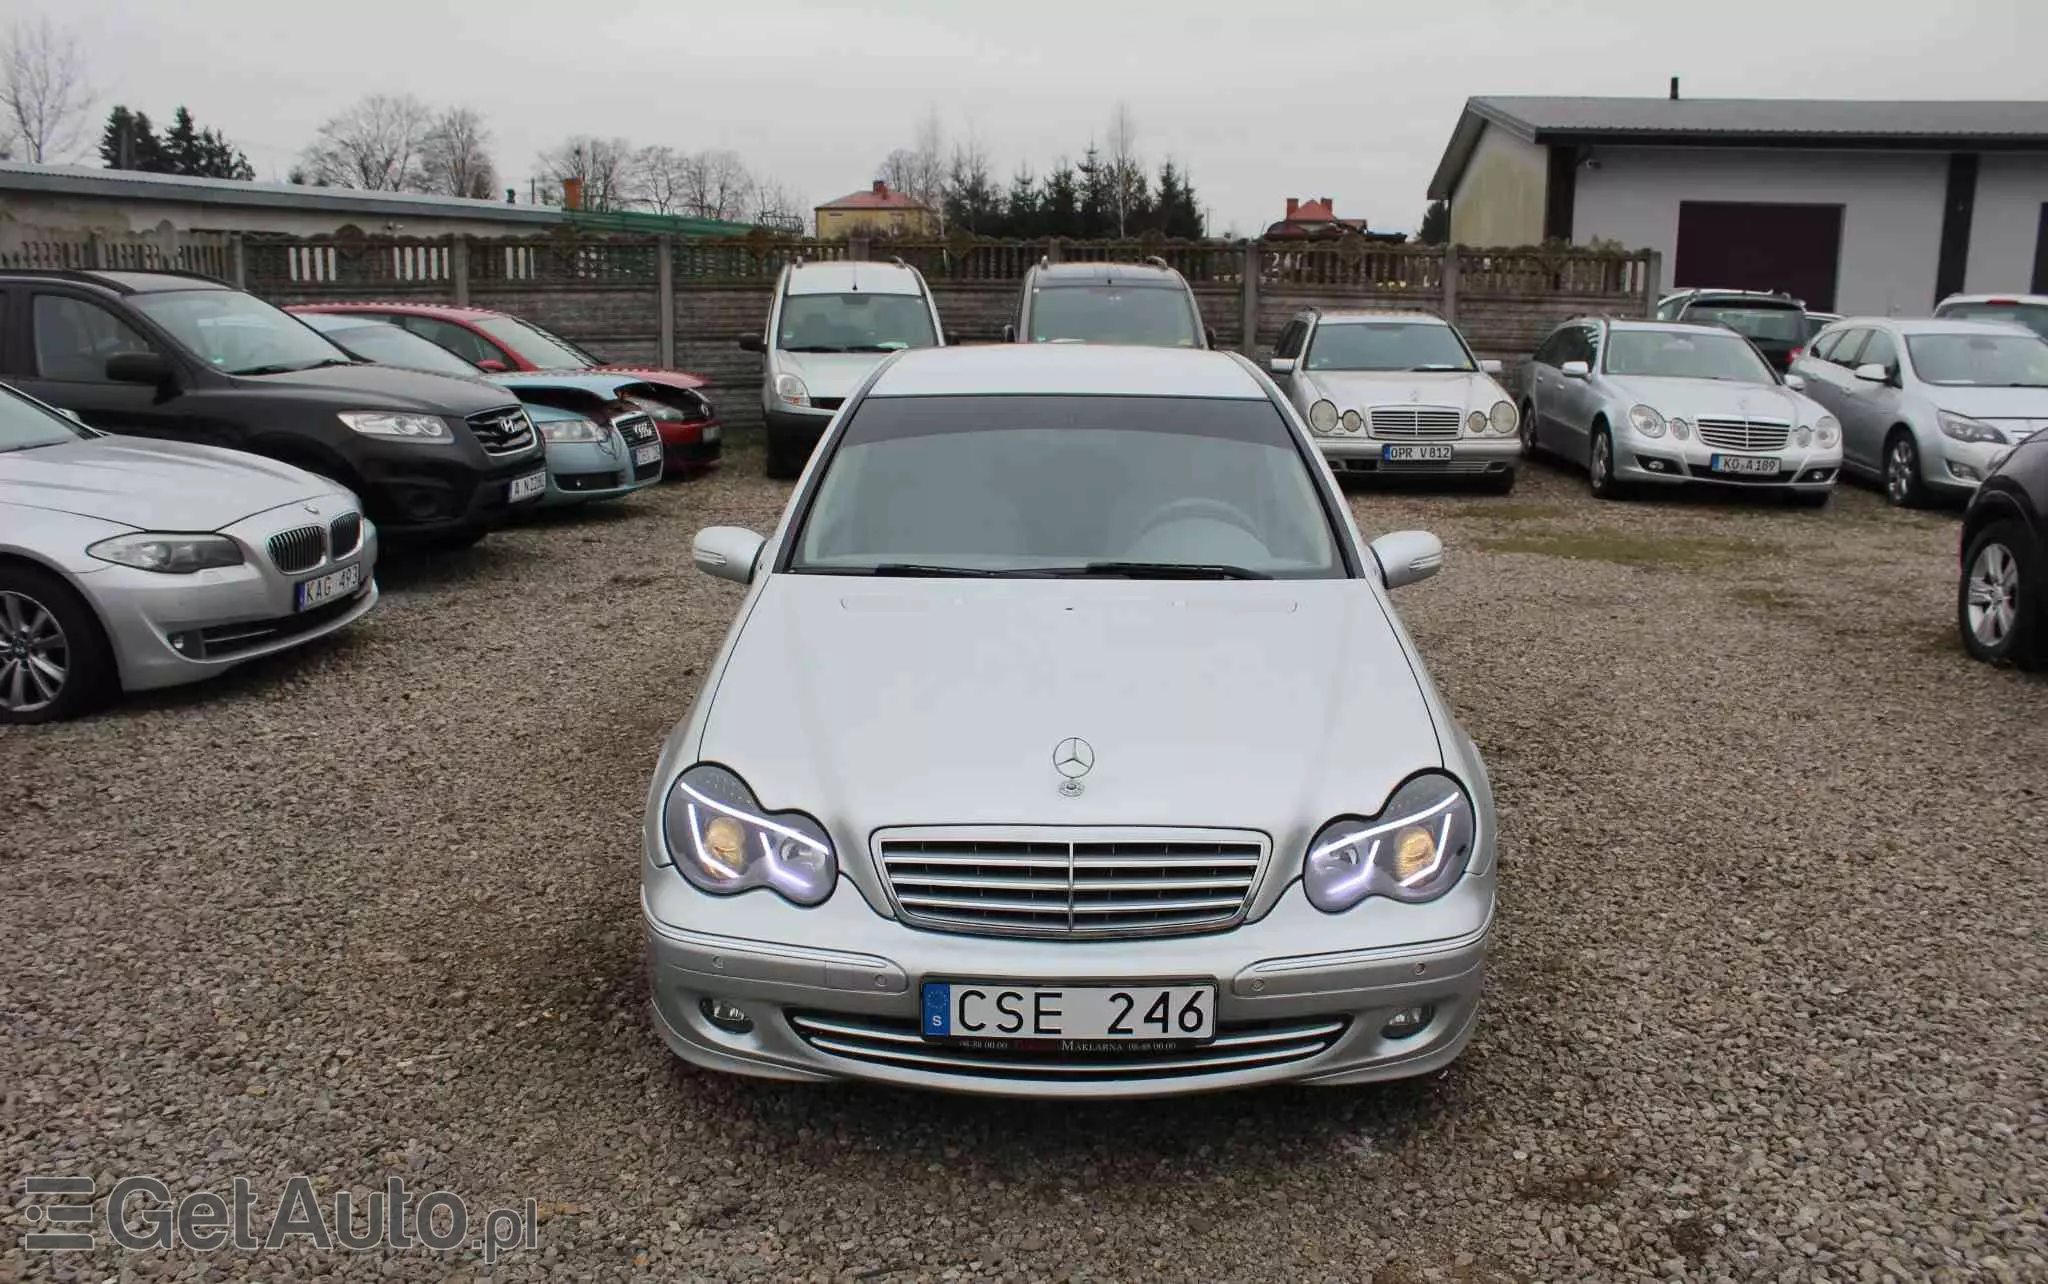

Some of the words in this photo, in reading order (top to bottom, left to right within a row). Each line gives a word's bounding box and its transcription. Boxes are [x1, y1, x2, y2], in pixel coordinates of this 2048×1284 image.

[1391, 447, 1413, 458] OPR
[957, 989, 1063, 1035] CSE
[1107, 990, 1205, 1035] 246
